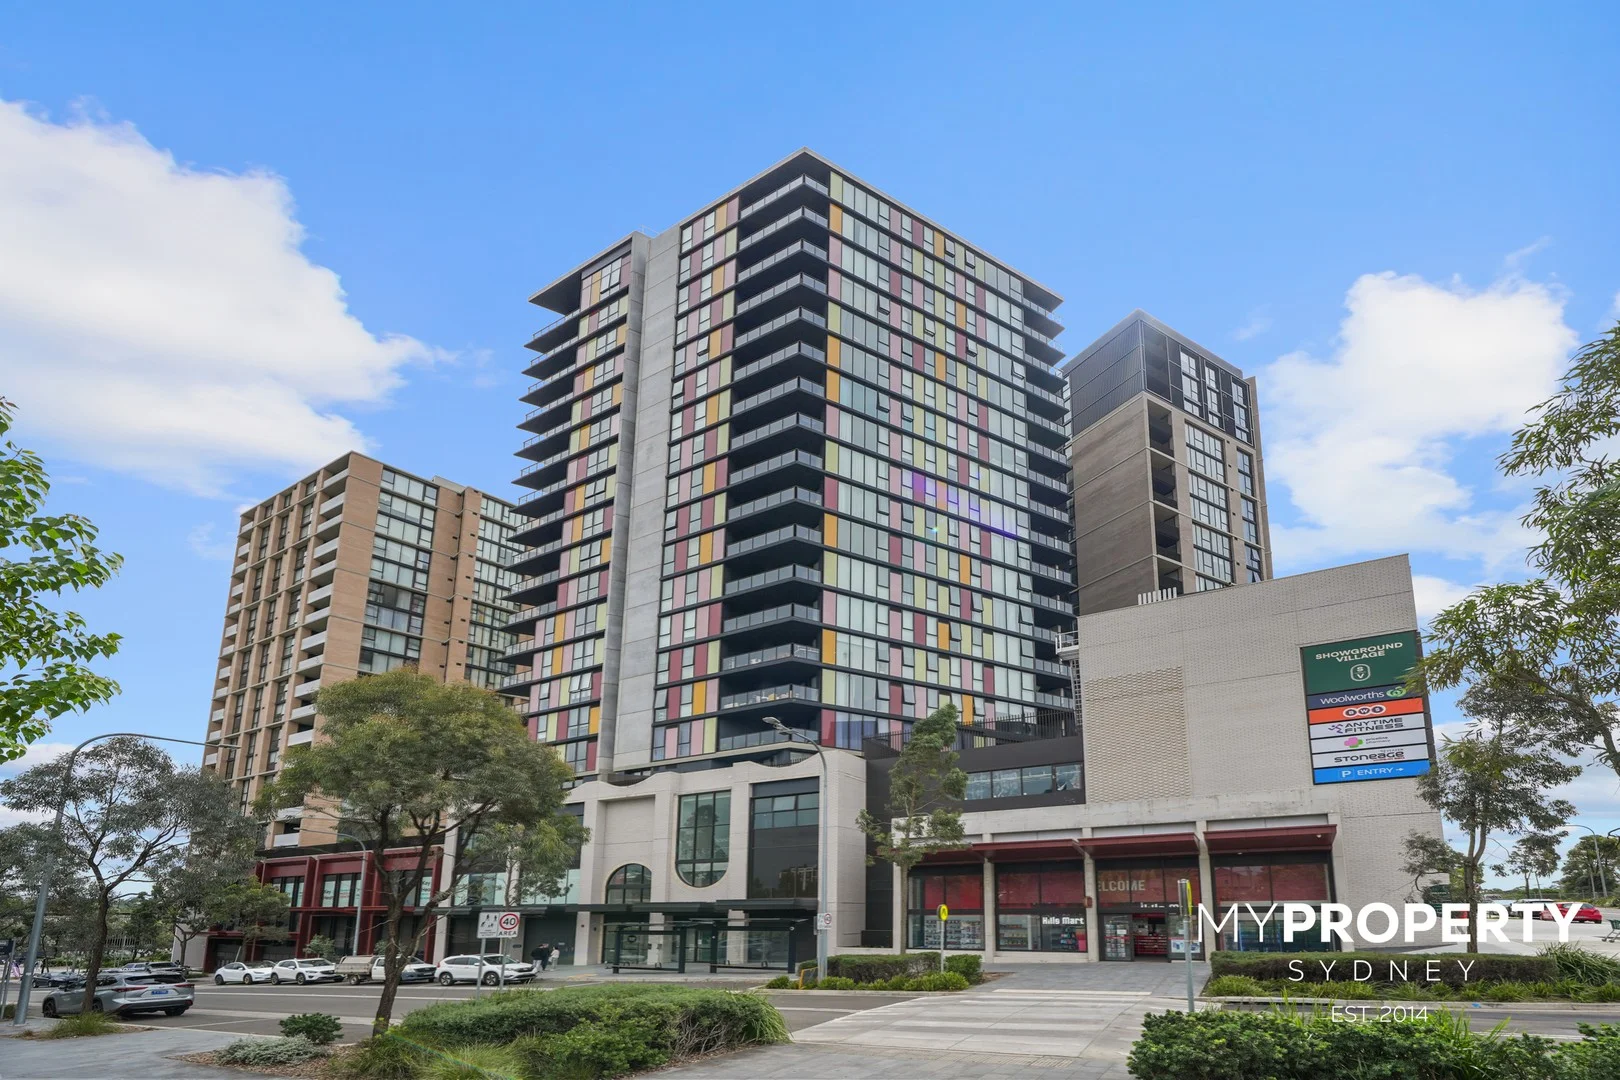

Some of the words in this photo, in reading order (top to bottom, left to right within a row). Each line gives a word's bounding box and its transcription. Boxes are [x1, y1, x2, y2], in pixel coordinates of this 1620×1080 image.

[1315, 642, 1403, 660] SHOWGROUND
[1336, 650, 1386, 663] VILLAGE
[1320, 691, 1385, 705] Woolworths
[1344, 718, 1403, 728] ANYTIME
[1344, 723, 1404, 733] FITNESS
[1341, 770, 1352, 778] P
[1357, 767, 1394, 776] ENTRY
[503, 917, 516, 926] 40
[1062, 916, 1085, 925] Mart
